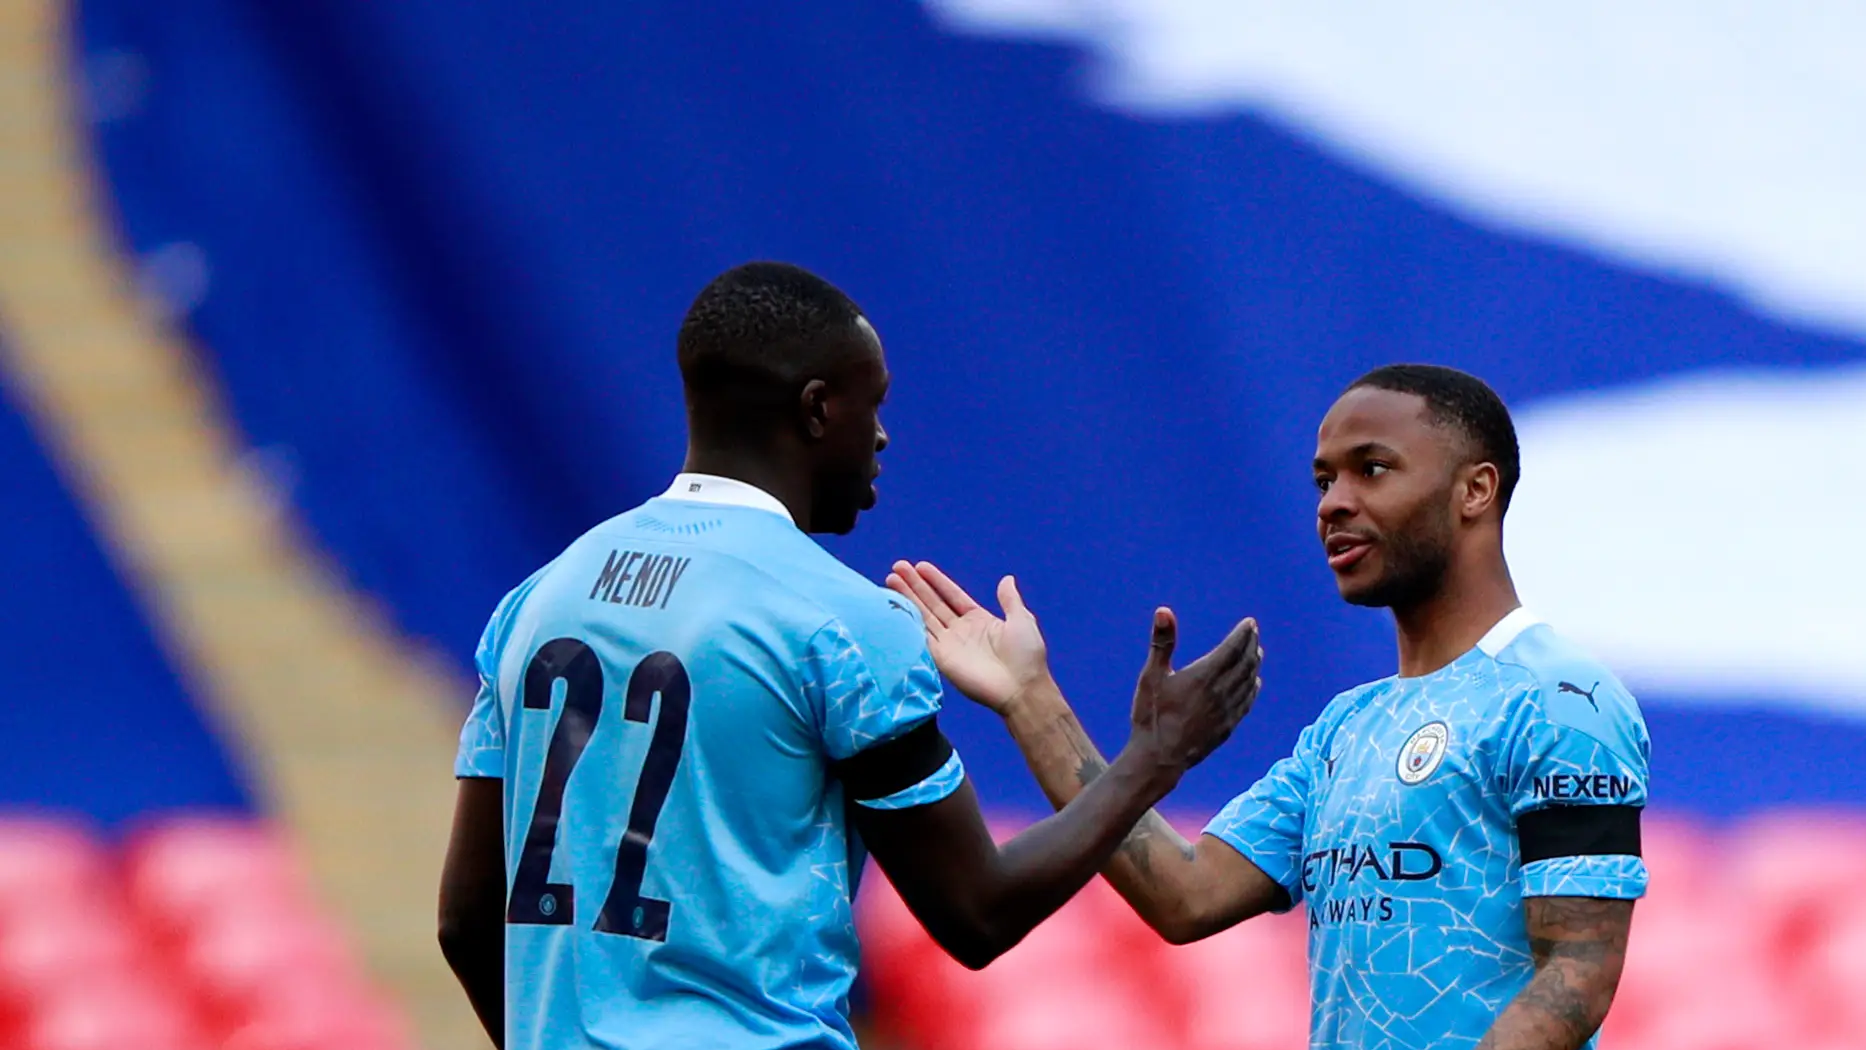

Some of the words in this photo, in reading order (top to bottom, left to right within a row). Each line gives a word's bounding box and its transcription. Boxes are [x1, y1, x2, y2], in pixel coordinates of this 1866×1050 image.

[589, 549, 692, 609] MENDY
[505, 637, 691, 943] 22
[1533, 774, 1630, 799] NEXEN
[1302, 842, 1442, 892] ETIHAD
[1310, 897, 1393, 931] AWAYS
